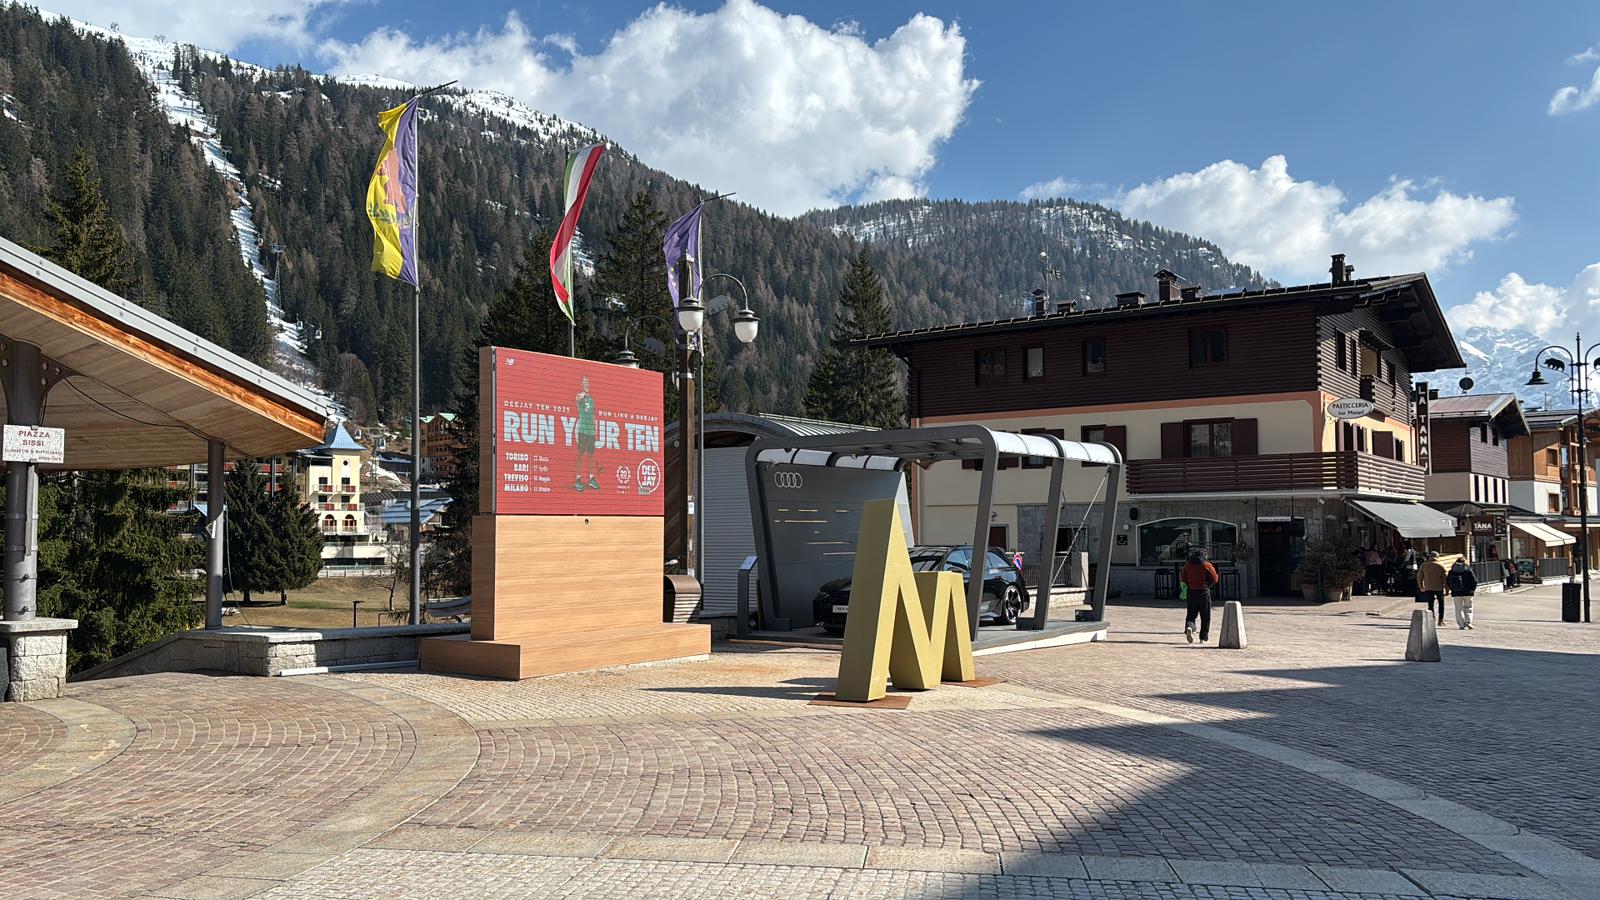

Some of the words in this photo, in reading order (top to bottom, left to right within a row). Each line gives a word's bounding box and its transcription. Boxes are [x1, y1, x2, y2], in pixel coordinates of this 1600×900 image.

[1417, 385, 1426, 405] LA
[504, 400, 533, 409] DEEJAY
[536, 403, 550, 411] TEN
[553, 405, 570, 413] 2025
[614, 411, 628, 419] LIKE
[635, 414, 658, 422] DEEJAY
[18, 430, 50, 438] PIAZZA
[504, 411, 554, 444] RUN
[625, 423, 659, 453] TEN
[1419, 414, 1428, 456] TANA
[22, 439, 44, 447] SISSI
[505, 452, 529, 462] TORINO
[513, 463, 529, 472] BARI
[641, 465, 657, 476] DEE
[503, 473, 529, 482] TREVISO
[641, 475, 657, 487] JAY
[503, 483, 529, 492] MILANO
